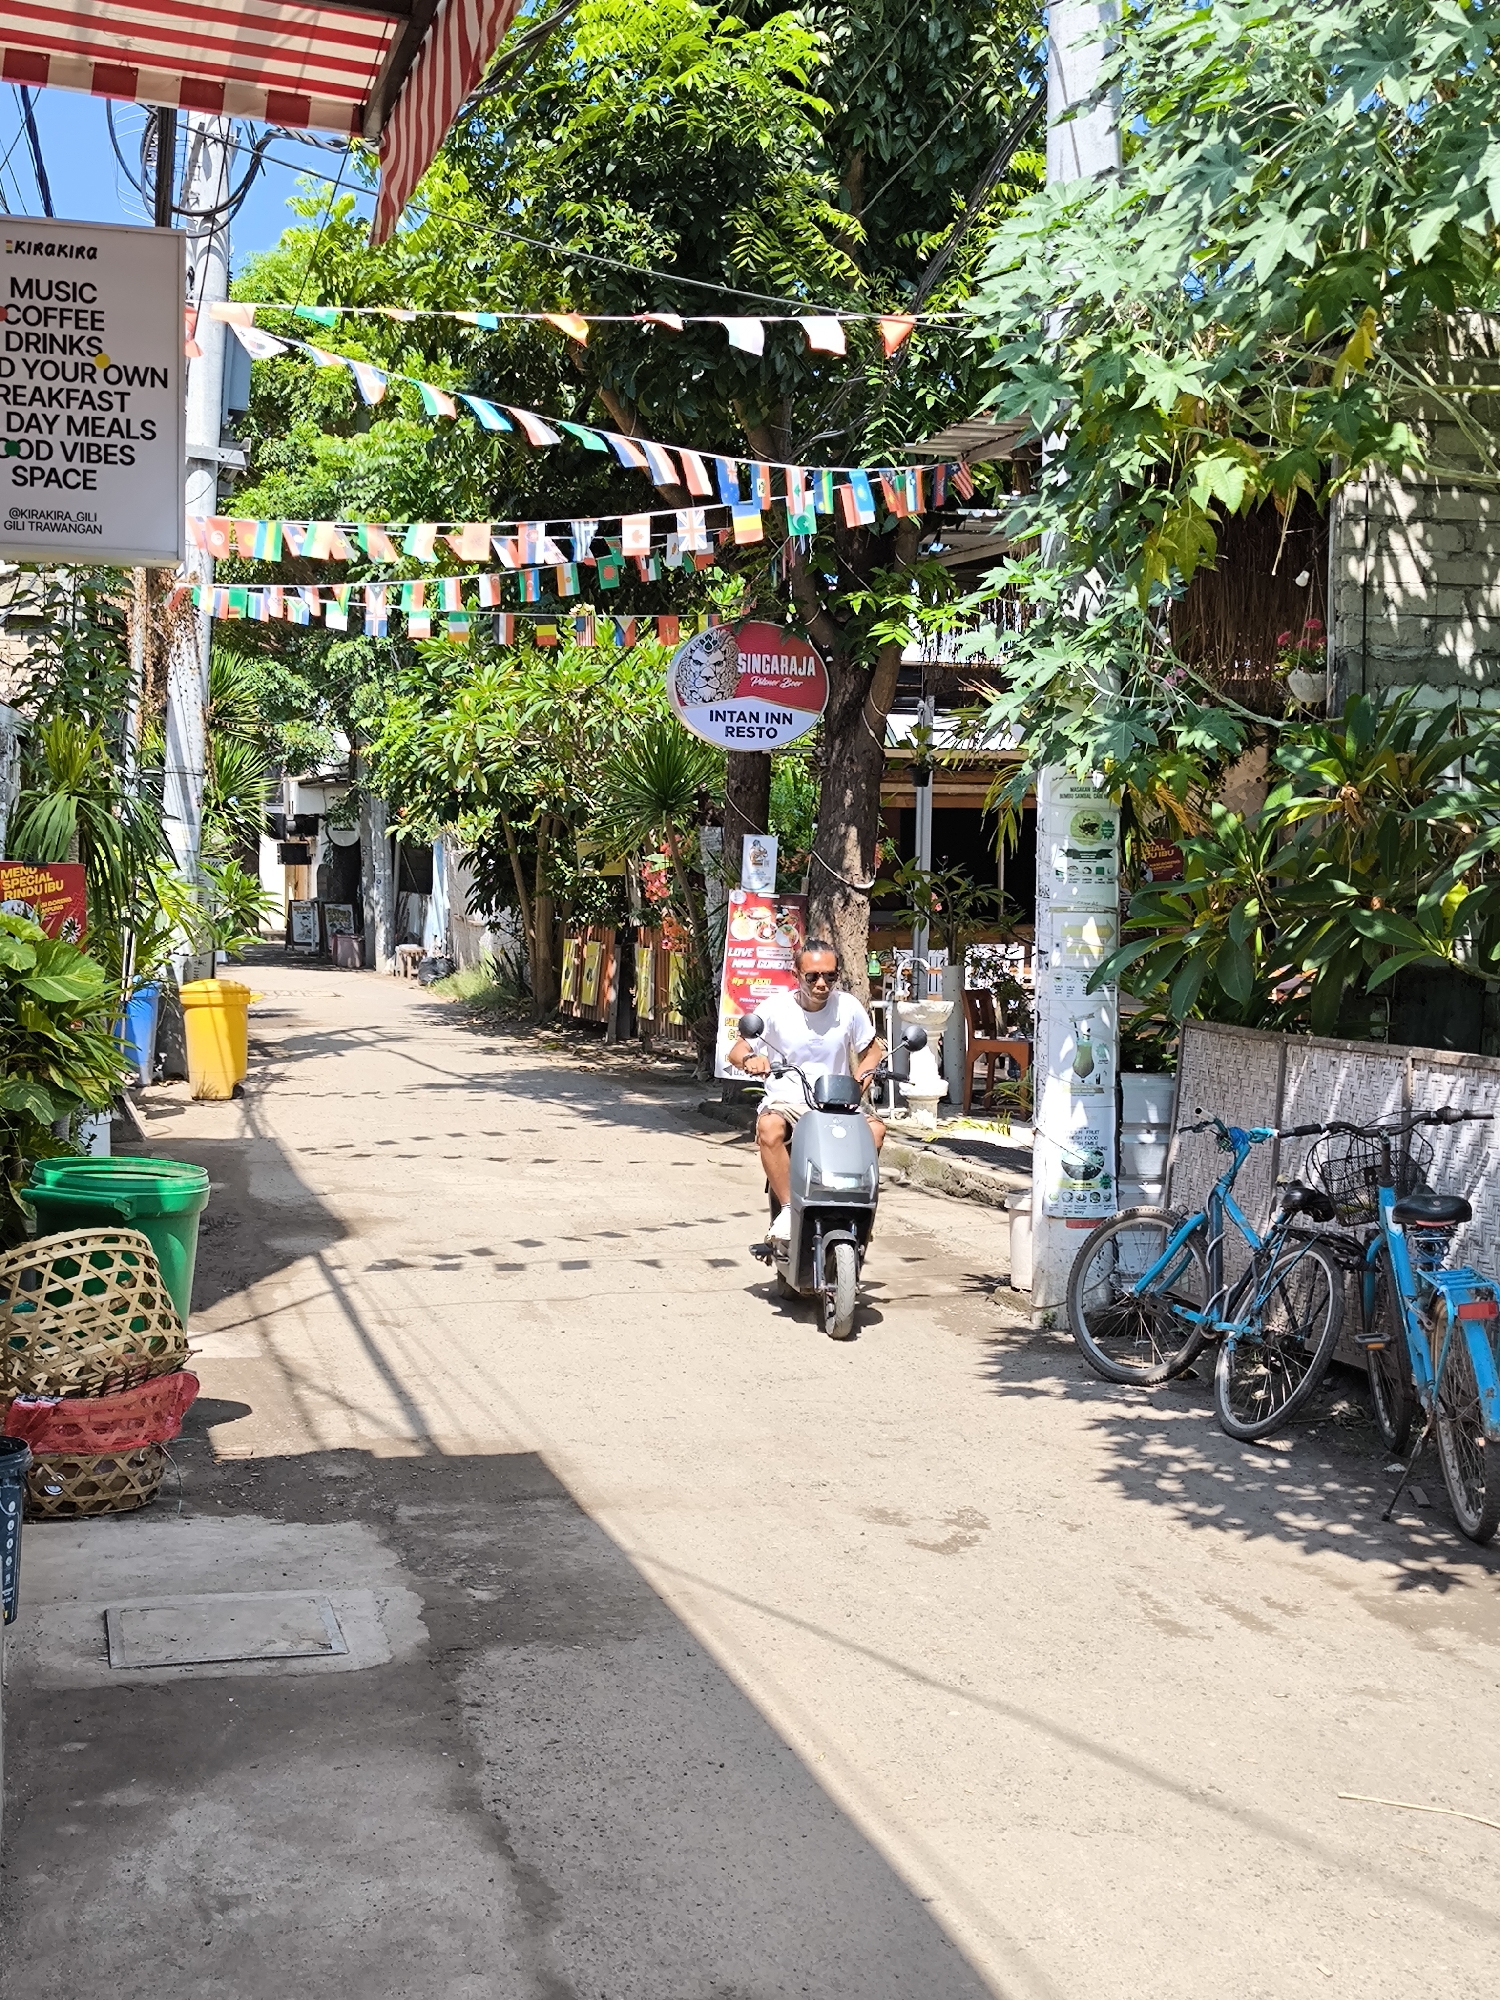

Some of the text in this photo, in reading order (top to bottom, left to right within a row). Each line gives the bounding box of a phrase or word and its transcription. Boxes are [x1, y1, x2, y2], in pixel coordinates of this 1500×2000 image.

[10, 276, 98, 304] MUSIC
[3, 303, 105, 331] COFFEE
[5, 330, 103, 357] DRINKS
[21, 357, 97, 384] YOUR
[103, 364, 168, 389] OWN
[6, 411, 157, 441] DAY MEALS
[60, 440, 136, 466] VIBES
[11, 465, 98, 491] SPACE
[8, 507, 97, 522] @KIRAKIRA_GILI
[3, 520, 103, 535] GILI TRAWANGAN
[737, 652, 816, 677] SINGARAJA
[750, 675, 804, 688] Pilsner Beer
[709, 709, 793, 725] INTAN INN
[725, 726, 778, 739] RESTO
[1158, 849, 1175, 858] IBU
[0, 866, 38, 880] MENU
[2, 872, 53, 890] SPECIAL
[3, 880, 64, 901] RINDU IBU
[727, 947, 755, 957] LOVE
[731, 977, 744, 986] Rp
